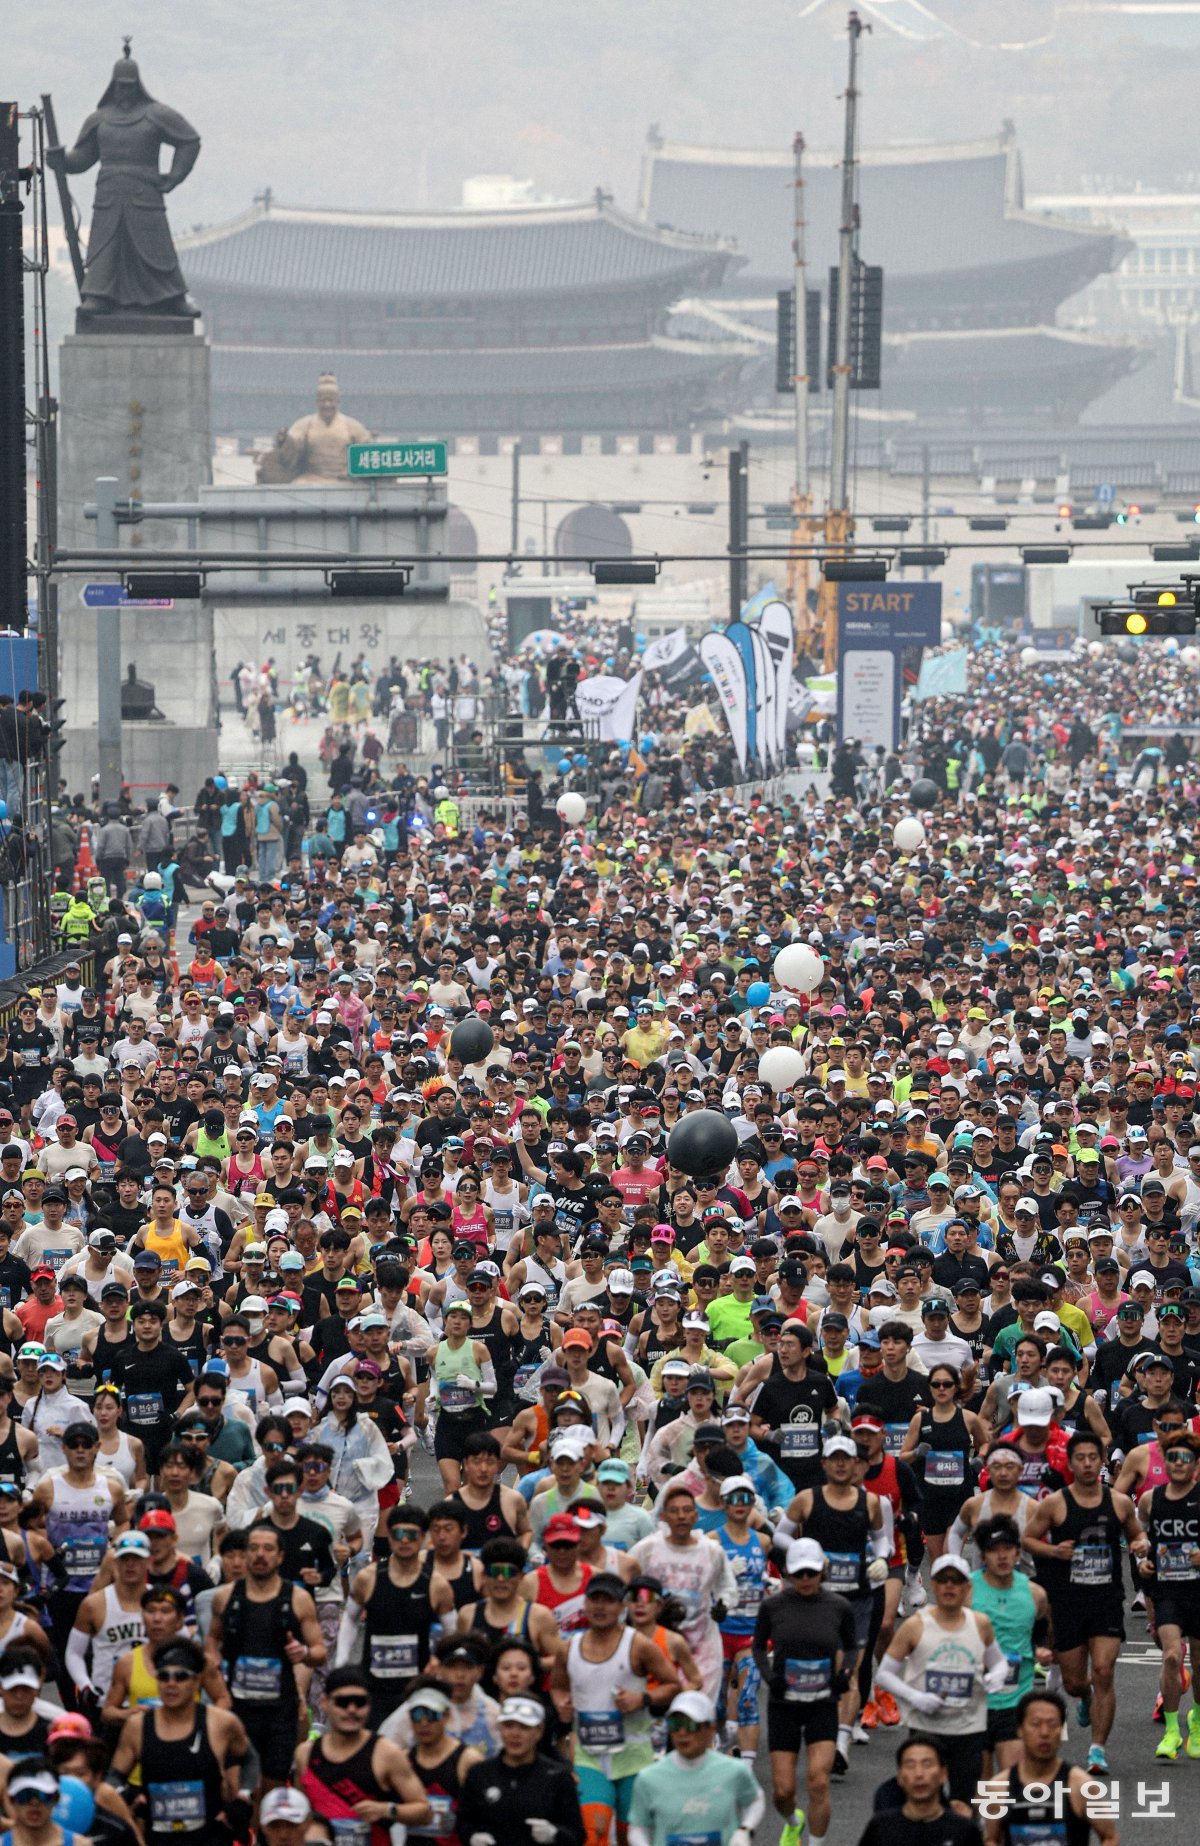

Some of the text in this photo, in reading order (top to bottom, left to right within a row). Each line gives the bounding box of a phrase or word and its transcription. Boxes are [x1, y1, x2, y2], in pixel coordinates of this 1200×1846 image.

[358, 449, 436, 469] 세종대로사거리
[846, 592, 915, 613] START
[262, 623, 382, 648] 세종대왕
[1153, 1519, 1199, 1537] SCRC
[106, 1622, 147, 1643] SWI
